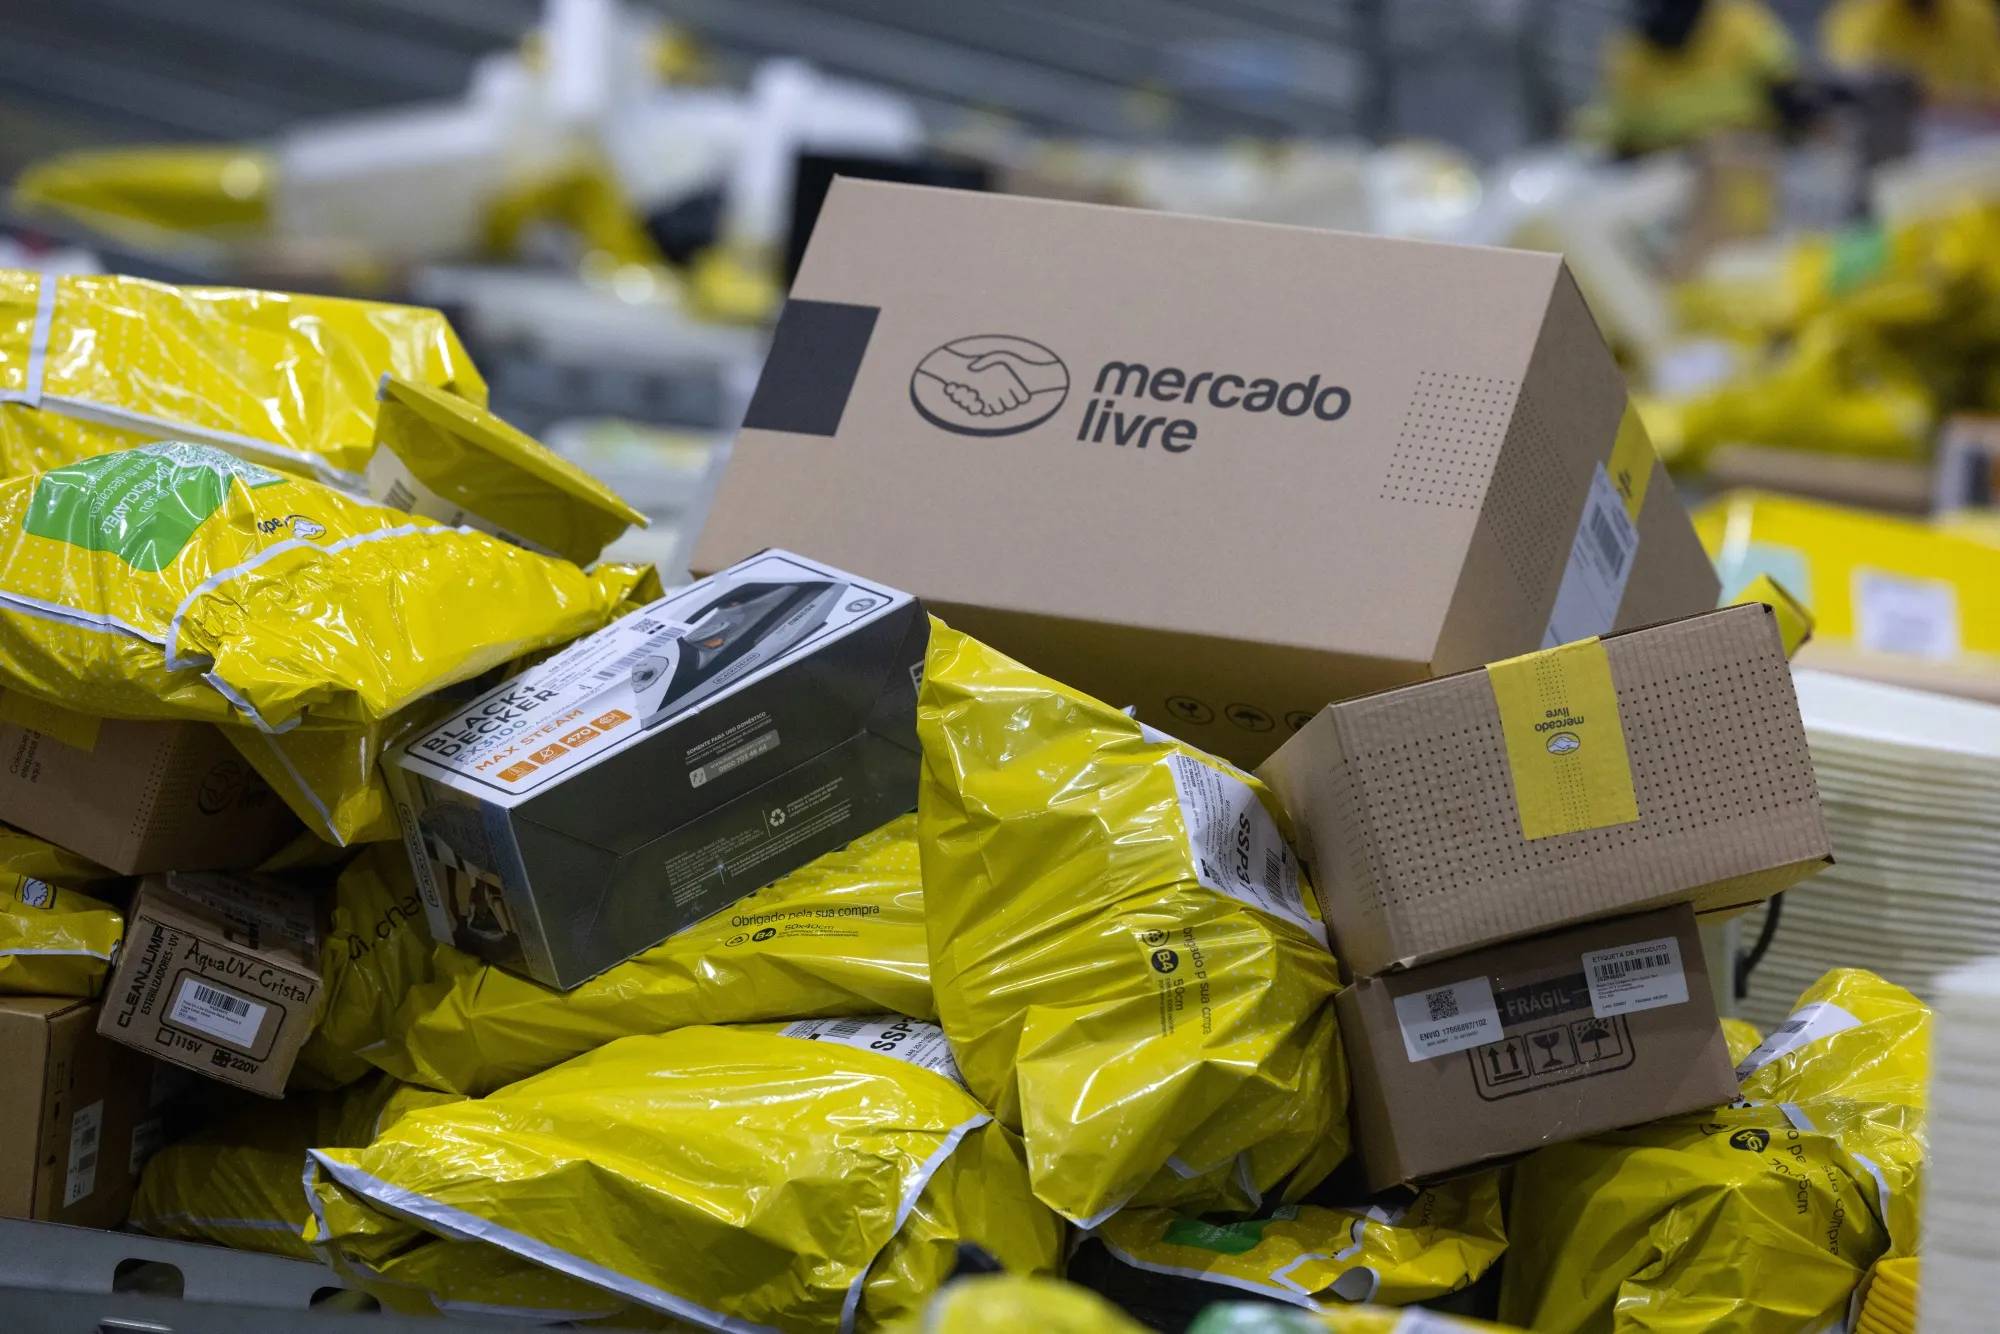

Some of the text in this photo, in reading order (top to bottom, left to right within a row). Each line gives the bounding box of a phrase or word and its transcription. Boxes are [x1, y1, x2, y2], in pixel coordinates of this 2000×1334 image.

[1094, 359, 1352, 422] mercado
[1076, 398, 1198, 453] livre
[137, 494, 158, 515] sou
[438, 690, 559, 757] DECKER
[1534, 716, 1584, 732] mercado
[1546, 707, 1570, 718] livre
[454, 720, 527, 763] FX3100
[474, 709, 584, 771] MAX STEAM
[566, 728, 593, 744] 470
[686, 739, 711, 756] SOMENTE
[711, 733, 726, 745] PARA
[726, 726, 737, 735] USO
[737, 711, 766, 729] DOMÉSTICO
[10, 734, 27, 774] Coloque
[376, 887, 422, 938] che
[732, 912, 785, 927] Obrigado
[815, 908, 835, 918] sua
[838, 905, 880, 918] compra
[755, 930, 774, 940] B4
[1157, 951, 1174, 972] B4
[1184, 927, 1203, 968] brigado
[1200, 982, 1209, 1004] sua
[1592, 953, 1624, 963] ETIQUETA
[1636, 944, 1667, 955] PRODUTO
[117, 925, 165, 1028] CLEANJUMP
[141, 950, 173, 1015] ESTERILIZADORES
[170, 934, 180, 946] UV
[1506, 988, 1570, 1018] FRÁGIL
[176, 1036, 202, 1053] 115V
[1420, 1028, 1441, 1041] ENVIO
[231, 1058, 259, 1075] 220V
[1821, 1165, 1838, 1193] sua
[1827, 1199, 1844, 1256] compra
